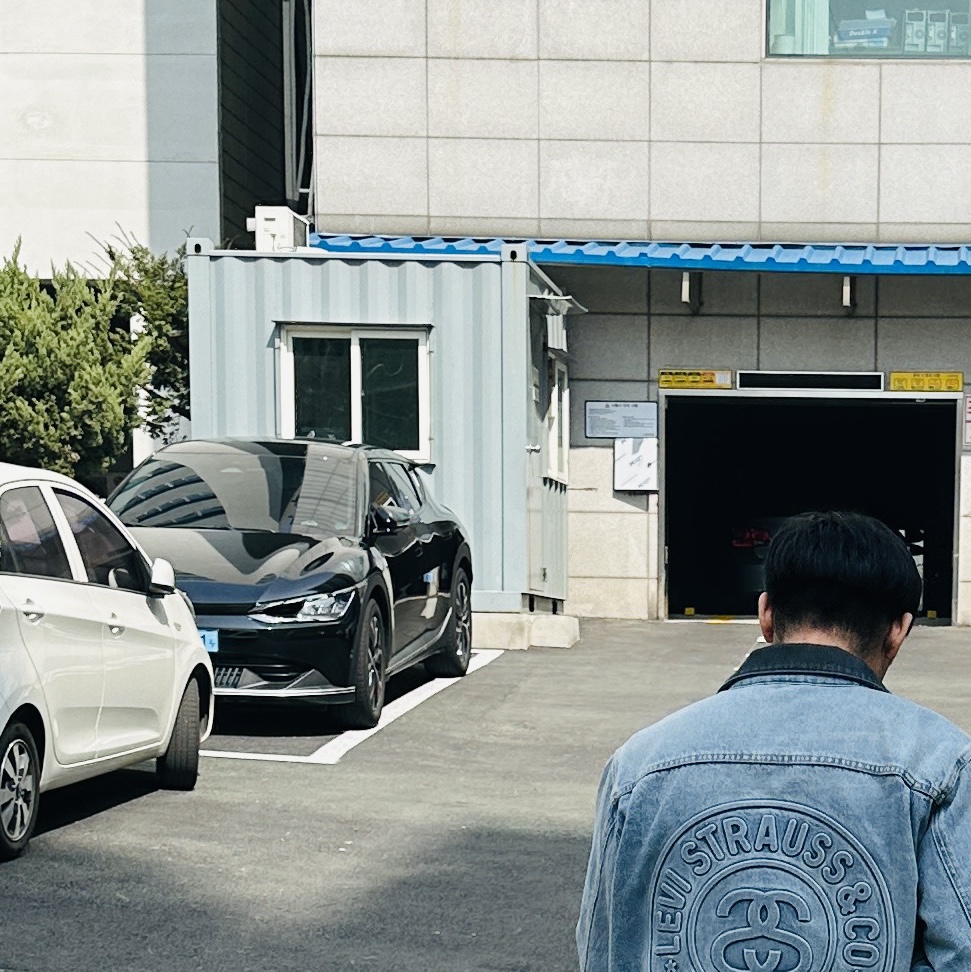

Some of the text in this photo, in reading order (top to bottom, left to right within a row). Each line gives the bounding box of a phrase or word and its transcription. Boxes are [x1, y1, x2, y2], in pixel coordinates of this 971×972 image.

[655, 814, 880, 967] LEVI STRAUSS & CO
